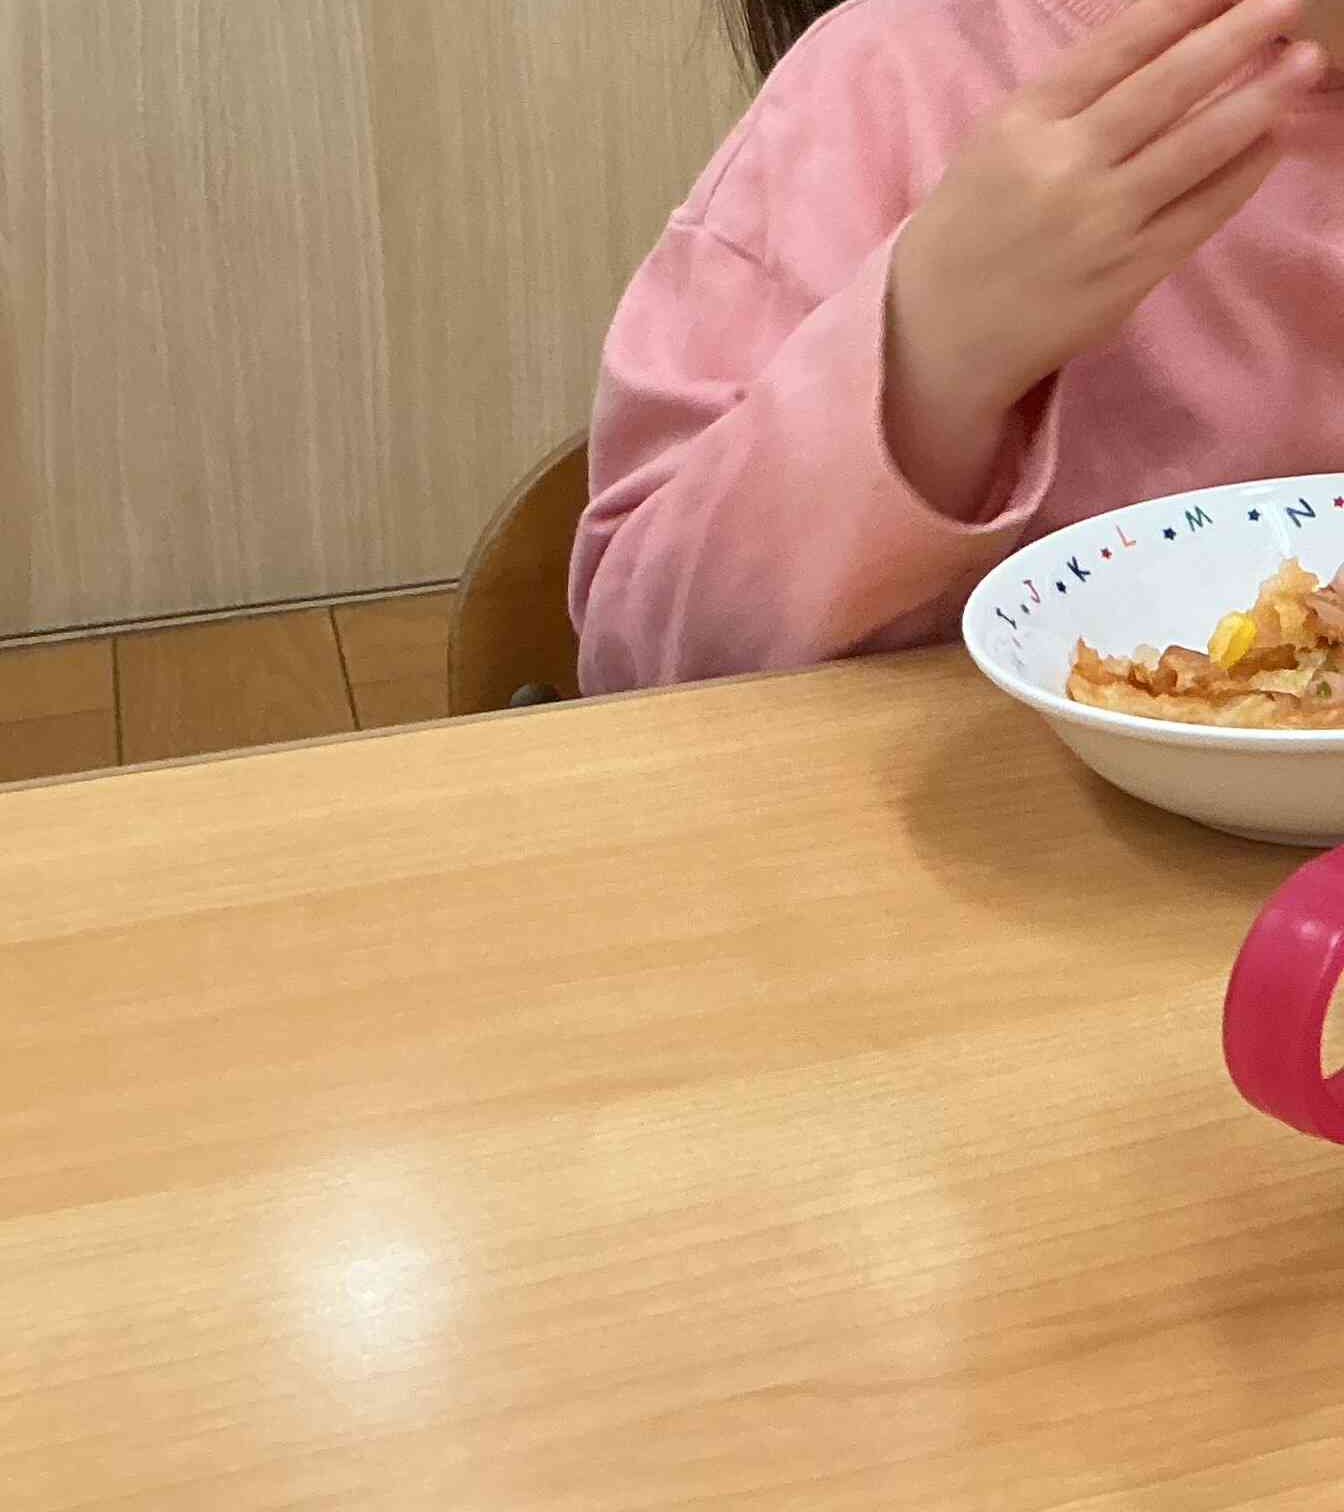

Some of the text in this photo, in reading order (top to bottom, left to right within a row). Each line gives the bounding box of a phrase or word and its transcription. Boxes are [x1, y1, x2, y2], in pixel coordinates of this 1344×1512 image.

[1023, 579, 1041, 604] J
[1067, 556, 1091, 582] K
[1116, 524, 1137, 548] L
[1184, 504, 1215, 533] M
[1286, 498, 1317, 529] N
